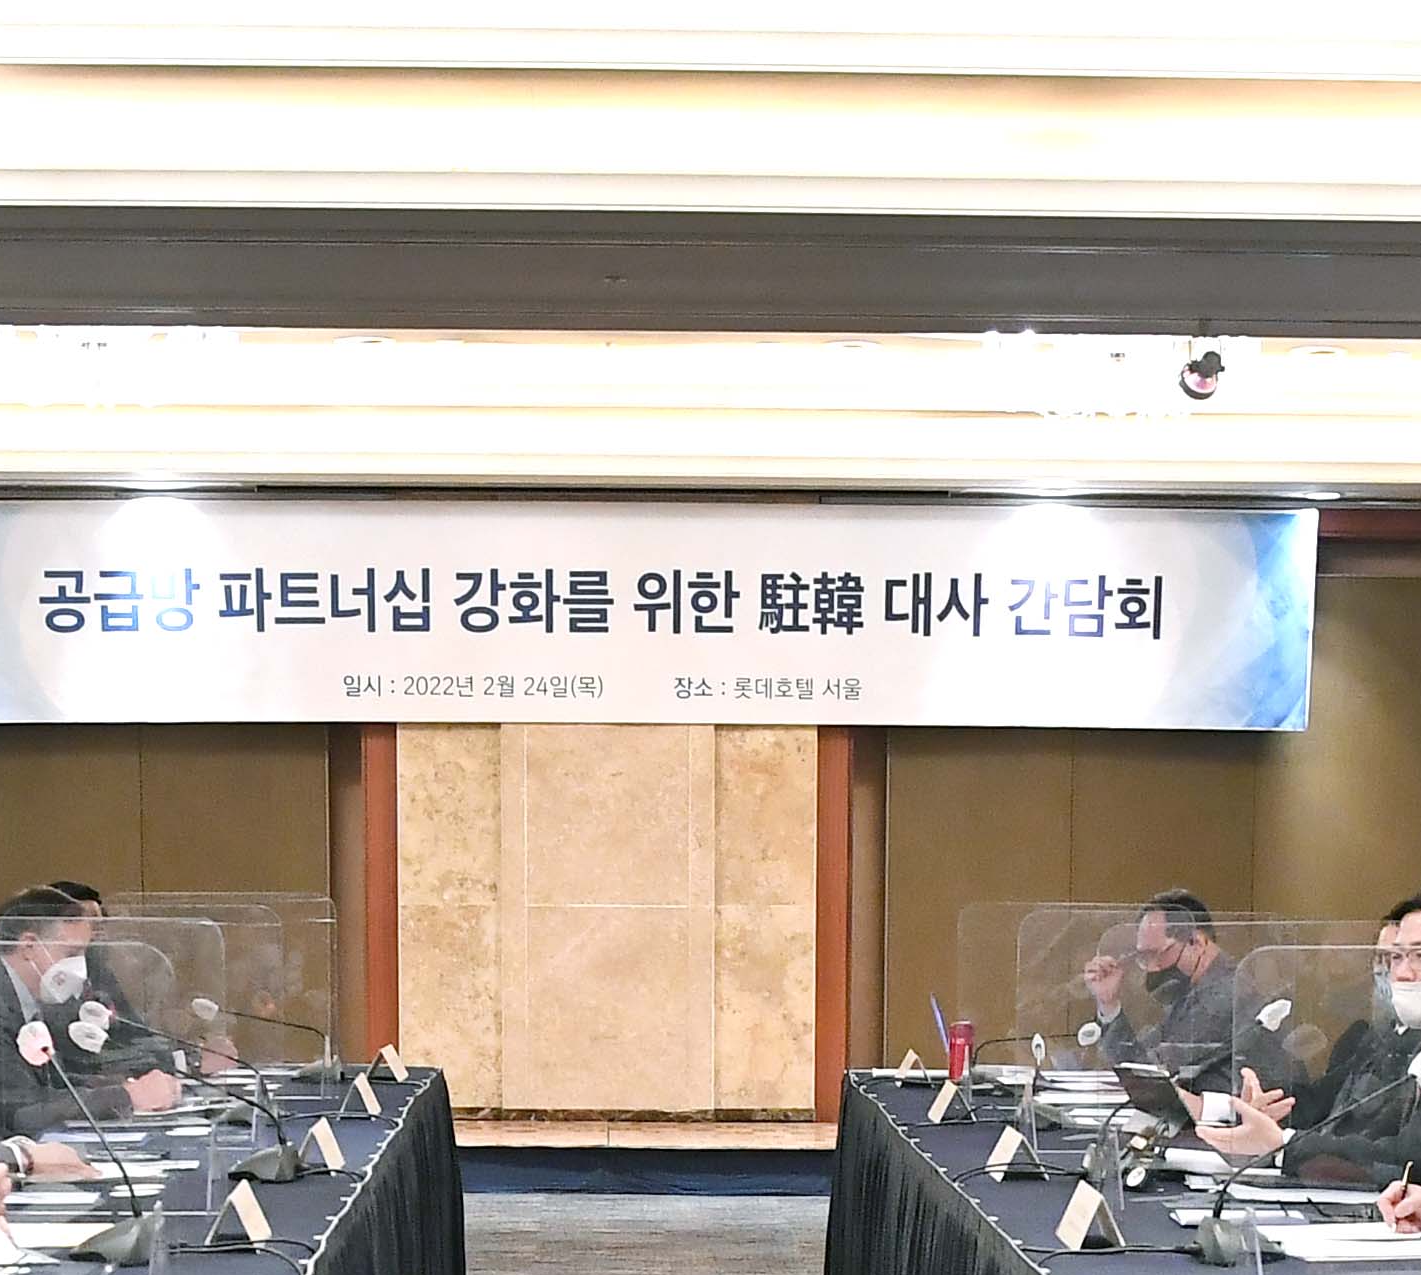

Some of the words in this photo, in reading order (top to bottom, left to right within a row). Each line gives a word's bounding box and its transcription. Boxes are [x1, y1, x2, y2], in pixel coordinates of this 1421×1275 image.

[38, 567, 200, 633] 공급망
[218, 567, 432, 633] 파트너십
[453, 568, 614, 634] 강화를
[633, 569, 740, 634] 위한
[757, 571, 865, 636] 駐韓
[884, 572, 989, 637] 대사
[1008, 574, 1164, 640] 간담회
[343, 675, 382, 698] 일시
[403, 675, 474, 698] 2022년
[483, 675, 515, 698] 2월
[523, 675, 604, 698] 24일(목)
[674, 676, 714, 700] 장소
[733, 677, 815, 700] 롯데호텔
[822, 677, 863, 701] 서울
